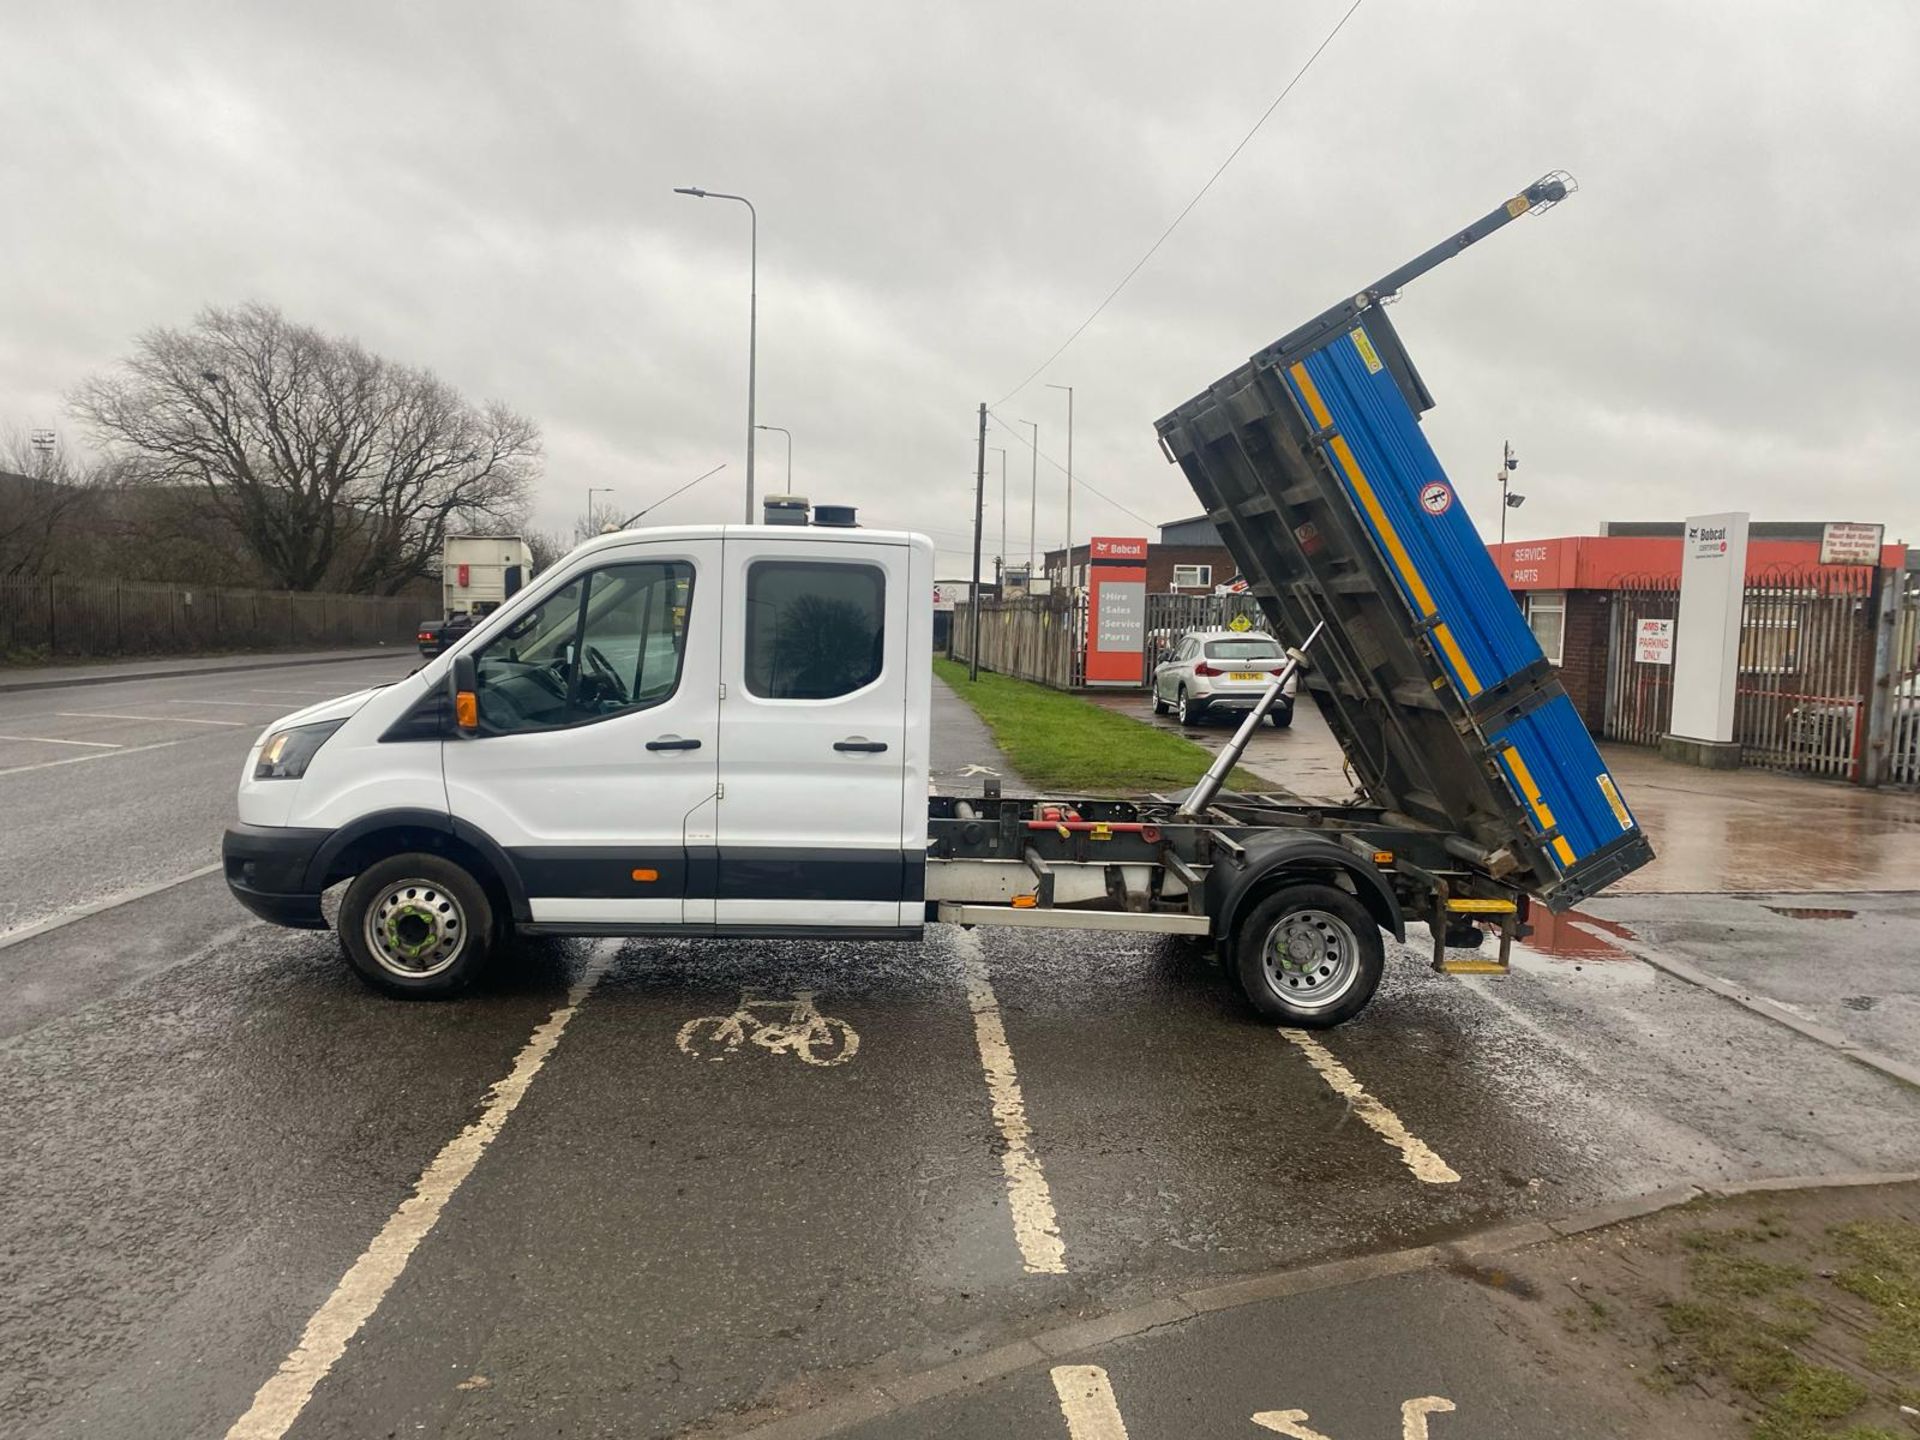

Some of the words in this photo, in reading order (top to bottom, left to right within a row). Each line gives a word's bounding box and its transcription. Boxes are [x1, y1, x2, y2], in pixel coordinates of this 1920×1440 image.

[1700, 527, 1726, 541] Bobcat
[1111, 544, 1141, 555] Bobcat
[1514, 546, 1547, 562] SERVICE
[1513, 569, 1539, 582] PARTS
[1105, 592, 1128, 601] Hire
[1639, 637, 1669, 648] PARKING
[1643, 650, 1661, 661] ONLY
